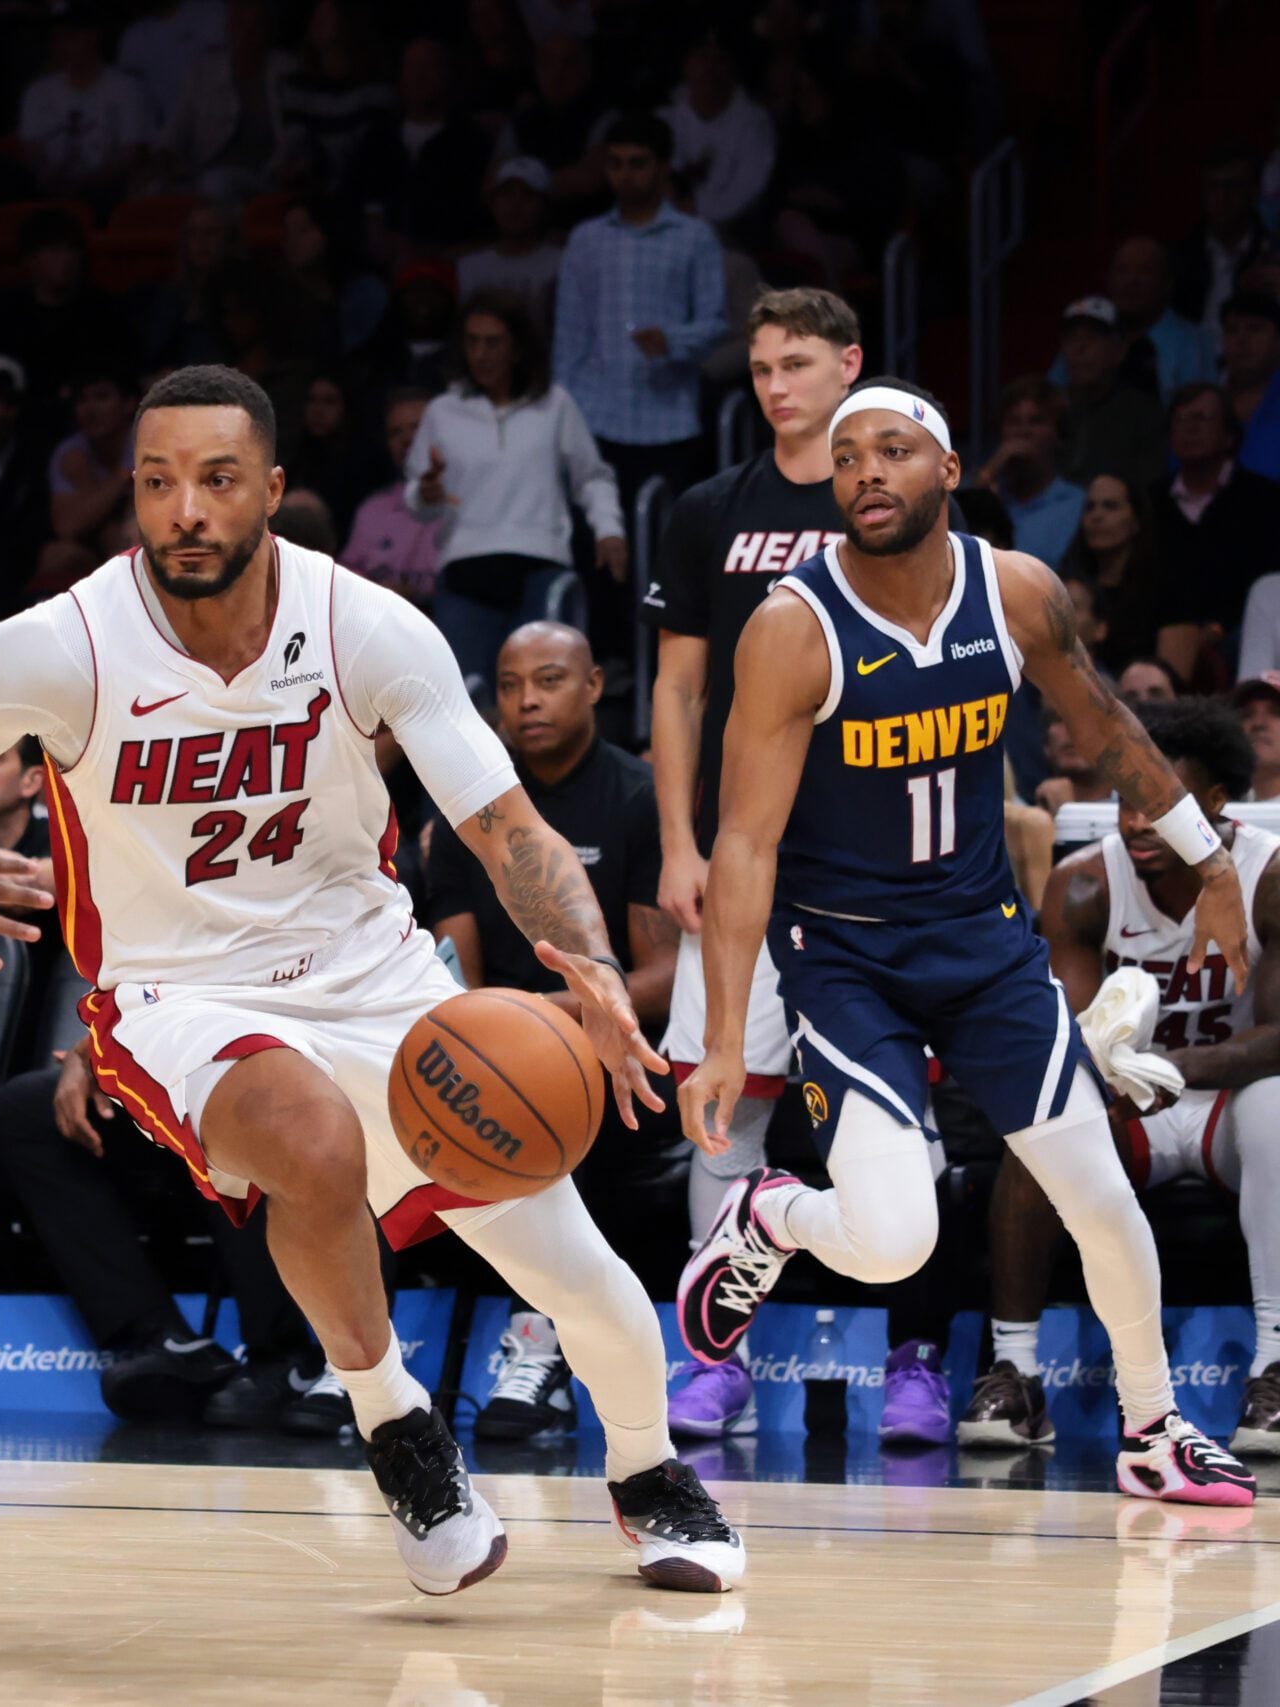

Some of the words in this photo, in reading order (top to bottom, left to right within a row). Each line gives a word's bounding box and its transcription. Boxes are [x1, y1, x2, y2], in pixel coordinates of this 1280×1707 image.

[950, 637, 996, 660] ibotta
[110, 687, 331, 804] HEAT
[841, 692, 1009, 769] DENVER
[186, 798, 311, 887] 24
[906, 766, 956, 864] 11
[1106, 950, 1228, 1005] EAT
[1152, 1004, 1232, 1051] 45
[416, 1040, 523, 1160] Wilson
[750, 1352, 886, 1388] ticketma
